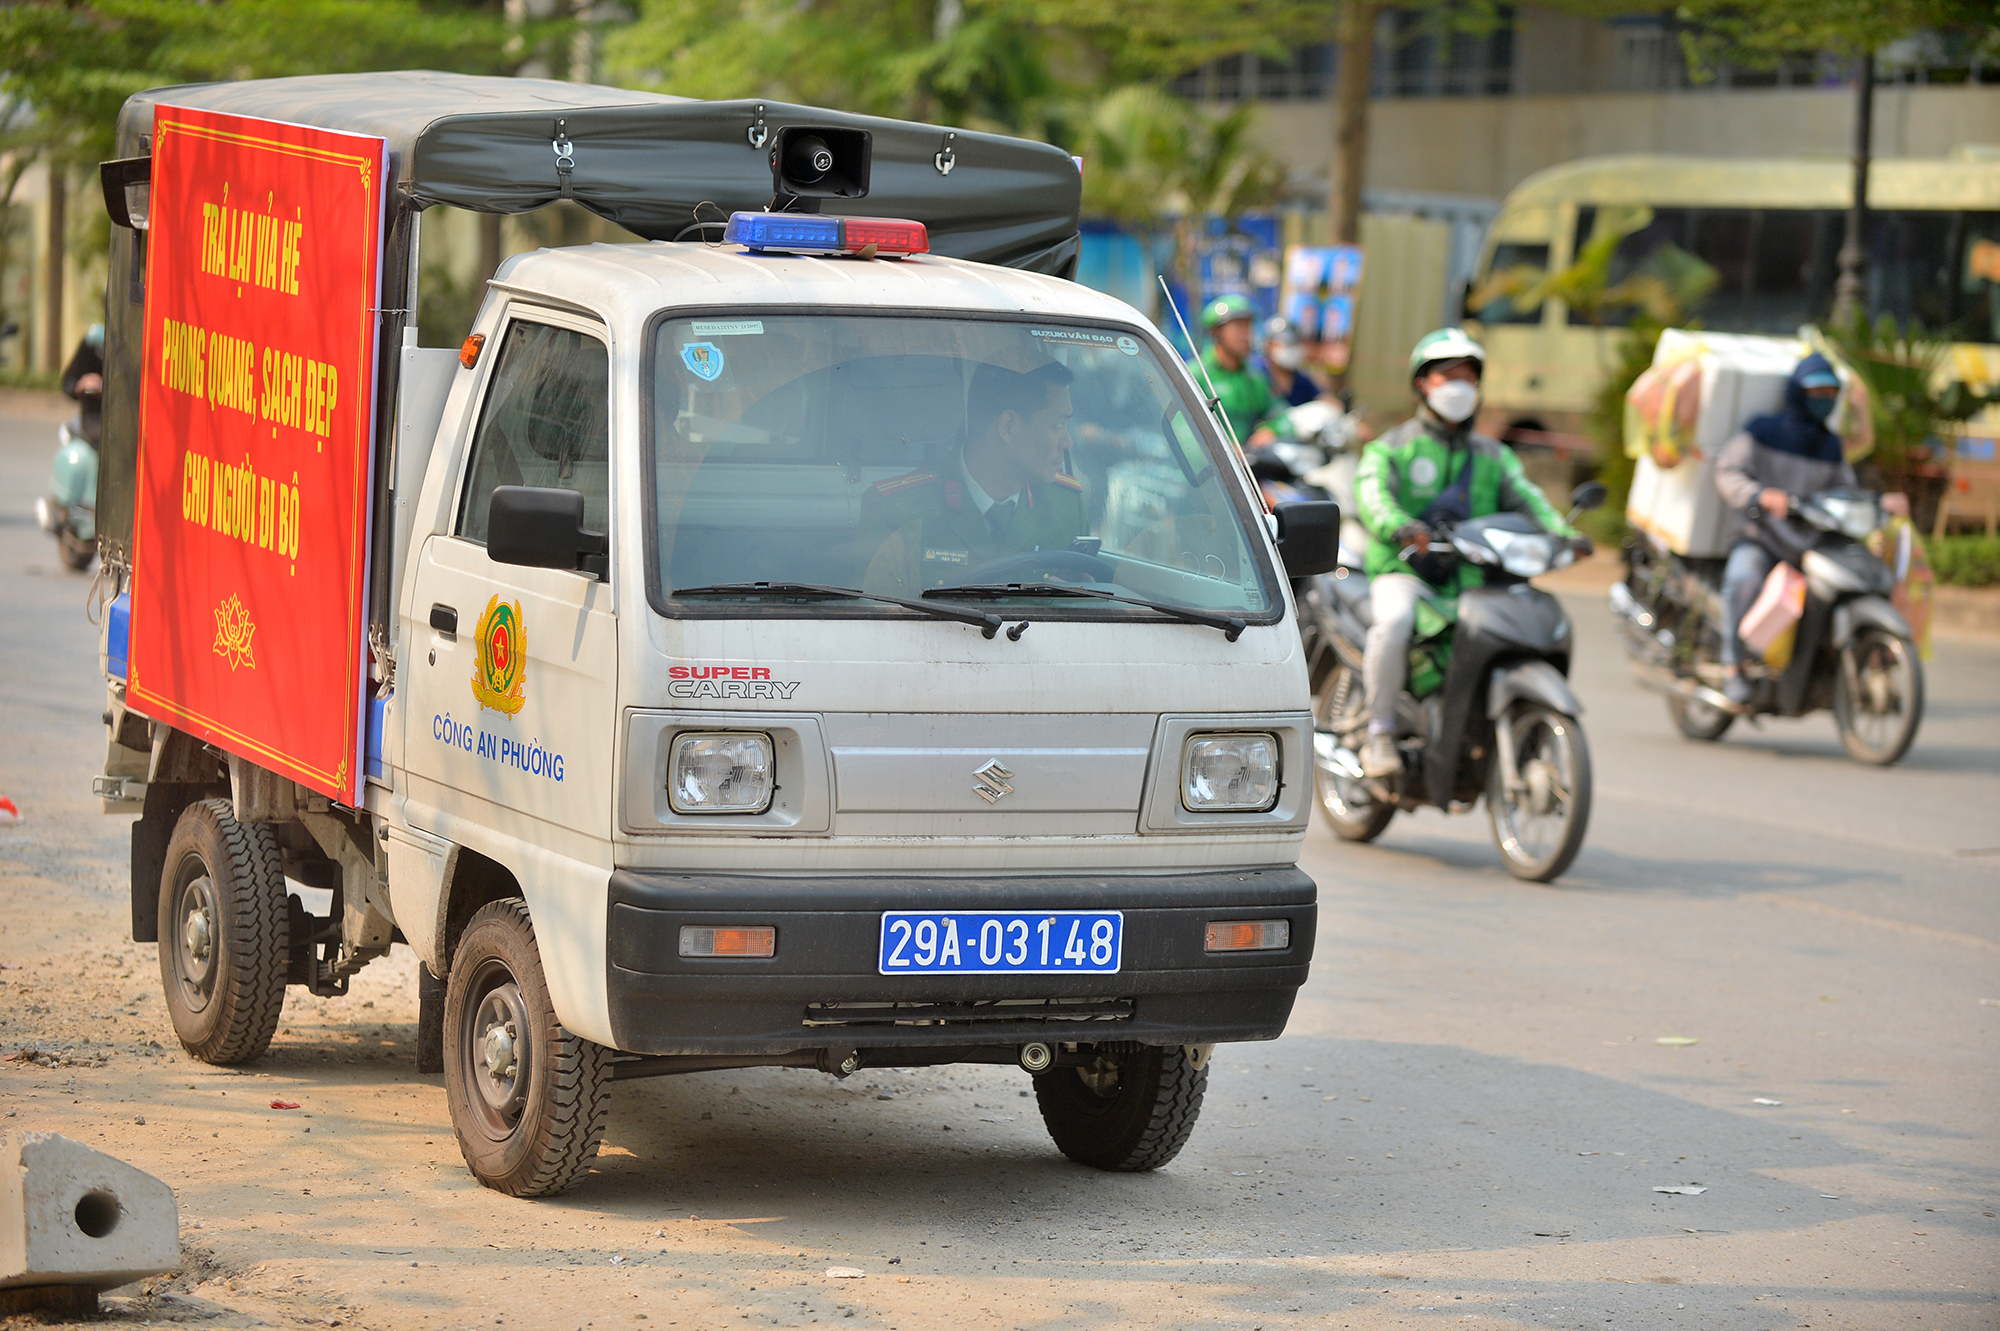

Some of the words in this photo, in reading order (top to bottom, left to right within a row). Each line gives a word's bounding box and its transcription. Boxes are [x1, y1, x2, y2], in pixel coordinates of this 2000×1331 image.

[201, 181, 229, 277] TRẢ
[228, 208, 254, 298] LẠI
[255, 190, 278, 290] VỈA
[280, 206, 302, 296] HÈ
[1030, 329, 1067, 339] SUZUKI
[1067, 331, 1090, 341] VÂN
[1091, 334, 1114, 343] ĐẠO
[161, 317, 206, 399] PHONG
[207, 331, 257, 425] QUANG,
[260, 346, 302, 439] SẠCH
[305, 358, 337, 453] ĐẸP
[182, 449, 210, 528] CHO
[212, 452, 256, 545] NGƯỜI
[259, 476, 275, 552] ĐI
[278, 470, 300, 577] BỘ
[667, 680, 801, 699] CARRY
[668, 666, 771, 679] SUPER
[432, 712, 473, 752] CÔNG
[477, 730, 497, 761] AN
[501, 737, 564, 782] PHƯỜNG
[888, 919, 1114, 966] 29A-031.48
